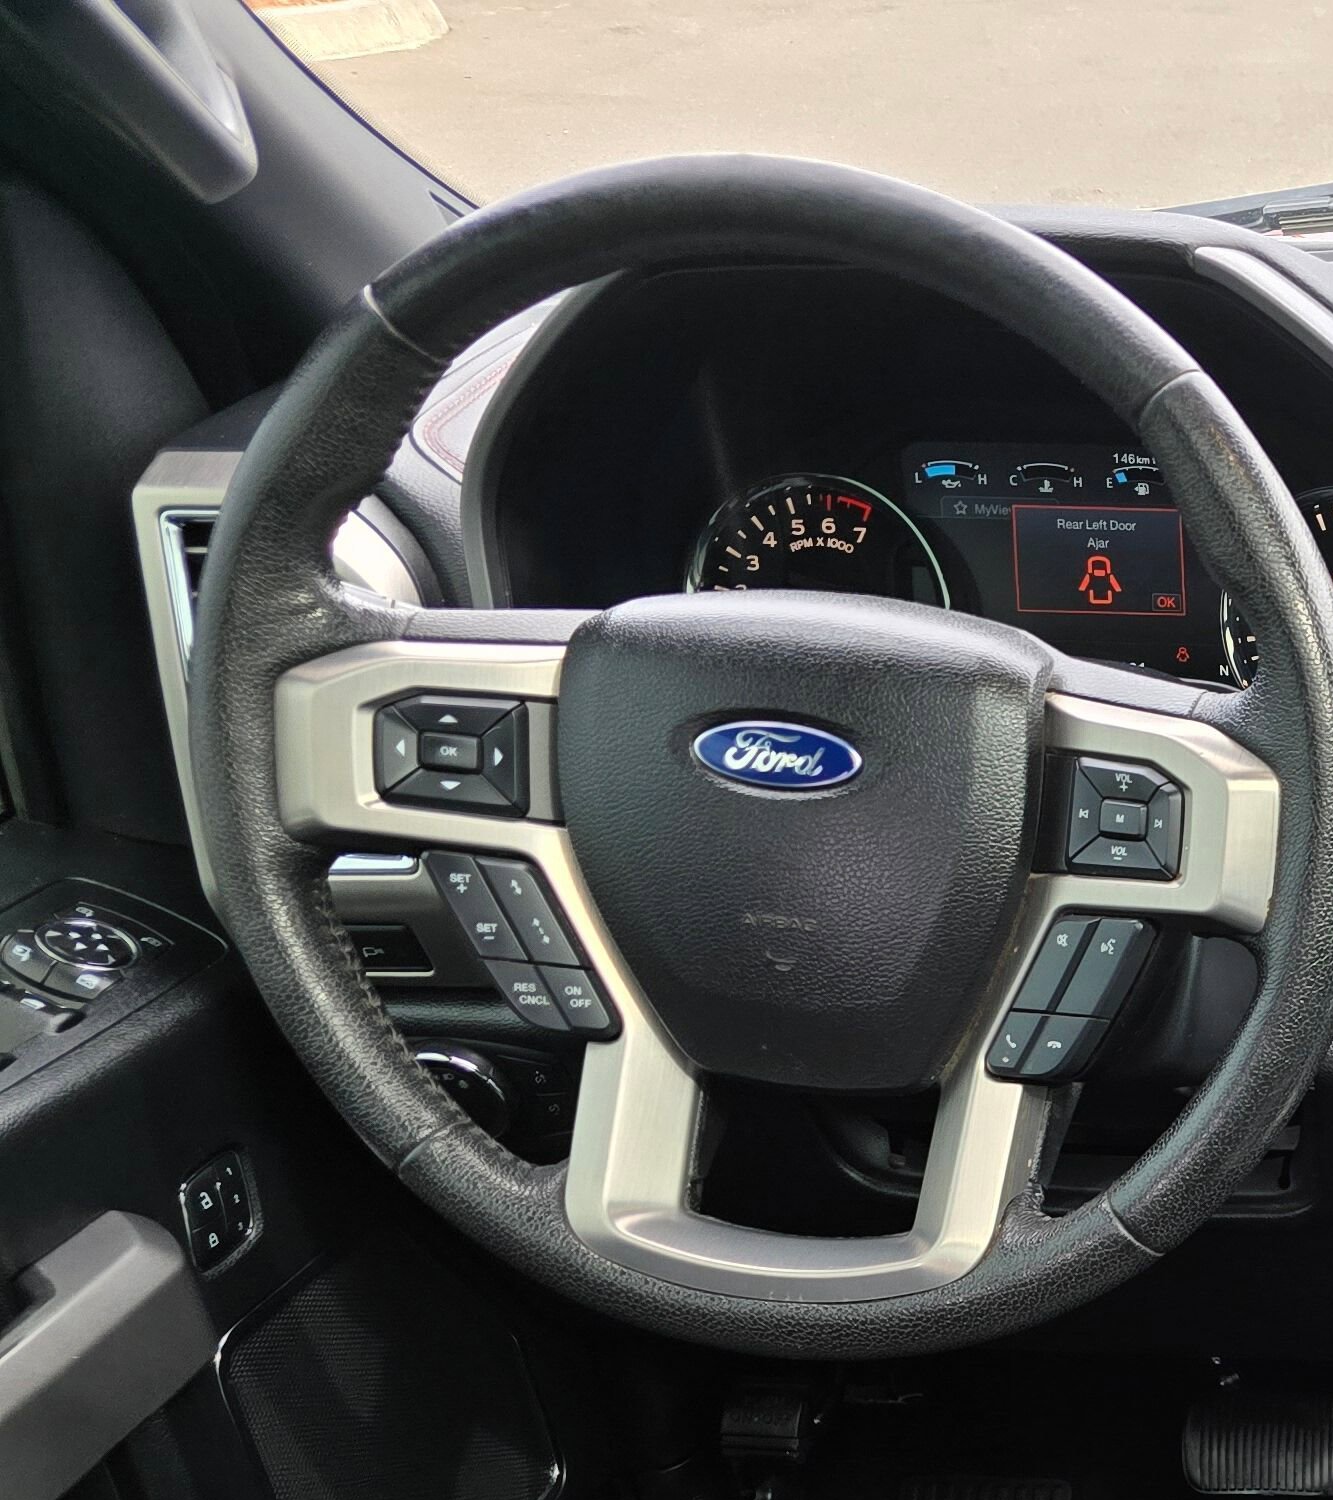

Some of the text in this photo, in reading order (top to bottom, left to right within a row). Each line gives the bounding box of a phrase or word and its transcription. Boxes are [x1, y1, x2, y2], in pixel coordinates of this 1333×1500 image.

[1113, 453, 1135, 464] 146
[915, 472, 922, 484] L
[978, 474, 987, 485] H
[1009, 475, 1018, 486] C
[1073, 477, 1083, 488] H
[1106, 478, 1113, 489] E
[974, 503, 1012, 517] MyVie
[791, 519, 805, 536] 5
[821, 517, 836, 534] 6
[1057, 518, 1136, 532] Rear Left Door
[762, 531, 777, 548] 4
[853, 527, 867, 544] 7
[789, 536, 855, 554] RPM X 1000
[1087, 537, 1110, 550] Ajar
[746, 554, 760, 571] 3
[1157, 596, 1176, 609] OK
[1219, 664, 1229, 677] N
[439, 745, 458, 758] OK
[723, 728, 826, 777] Ford
[1115, 773, 1133, 784] VOL
[1116, 814, 1125, 823] M
[1111, 845, 1128, 856] VOL
[450, 873, 471, 884] SET
[476, 923, 498, 934] SET
[513, 982, 537, 993] RES
[565, 985, 582, 996] ON
[519, 995, 550, 1006] CNCL
[570, 998, 592, 1009] OFF
